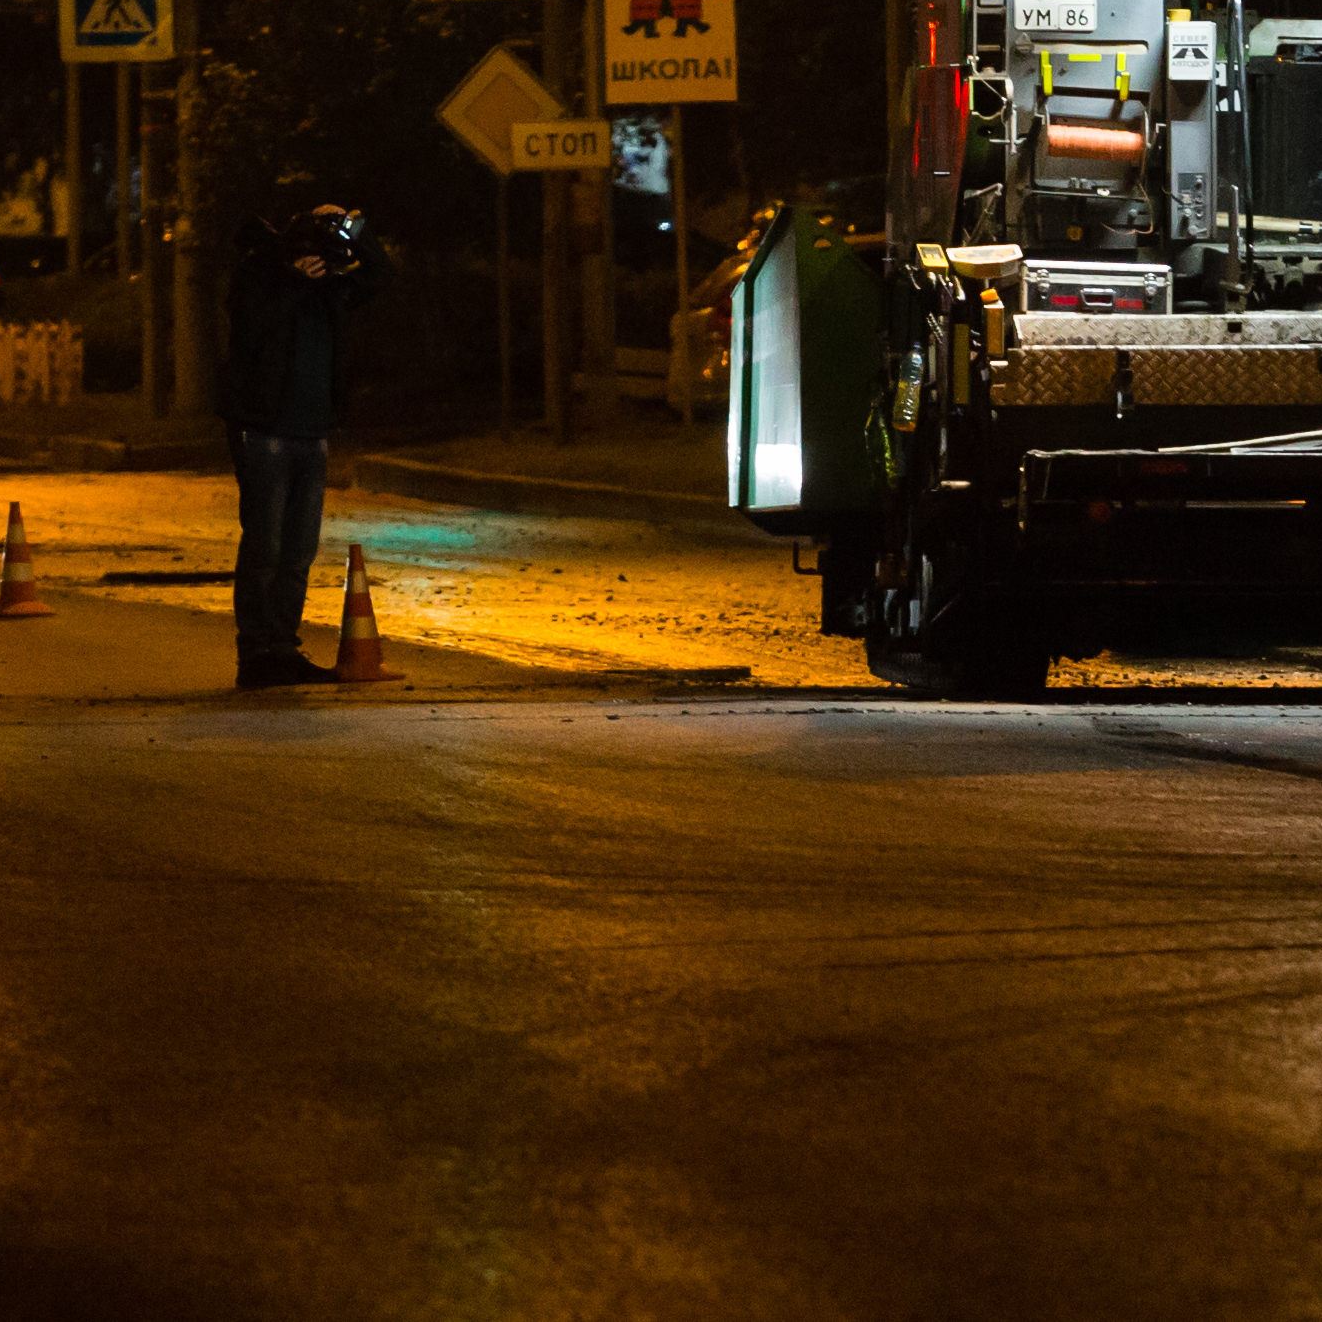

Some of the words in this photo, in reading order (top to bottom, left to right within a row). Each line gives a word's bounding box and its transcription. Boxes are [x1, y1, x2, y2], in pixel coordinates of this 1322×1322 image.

[1023, 9, 1051, 26] УМ
[1066, 9, 1089, 26] 86
[611, 58, 732, 81] ШКОЛА!
[524, 132, 597, 156] СТОП
